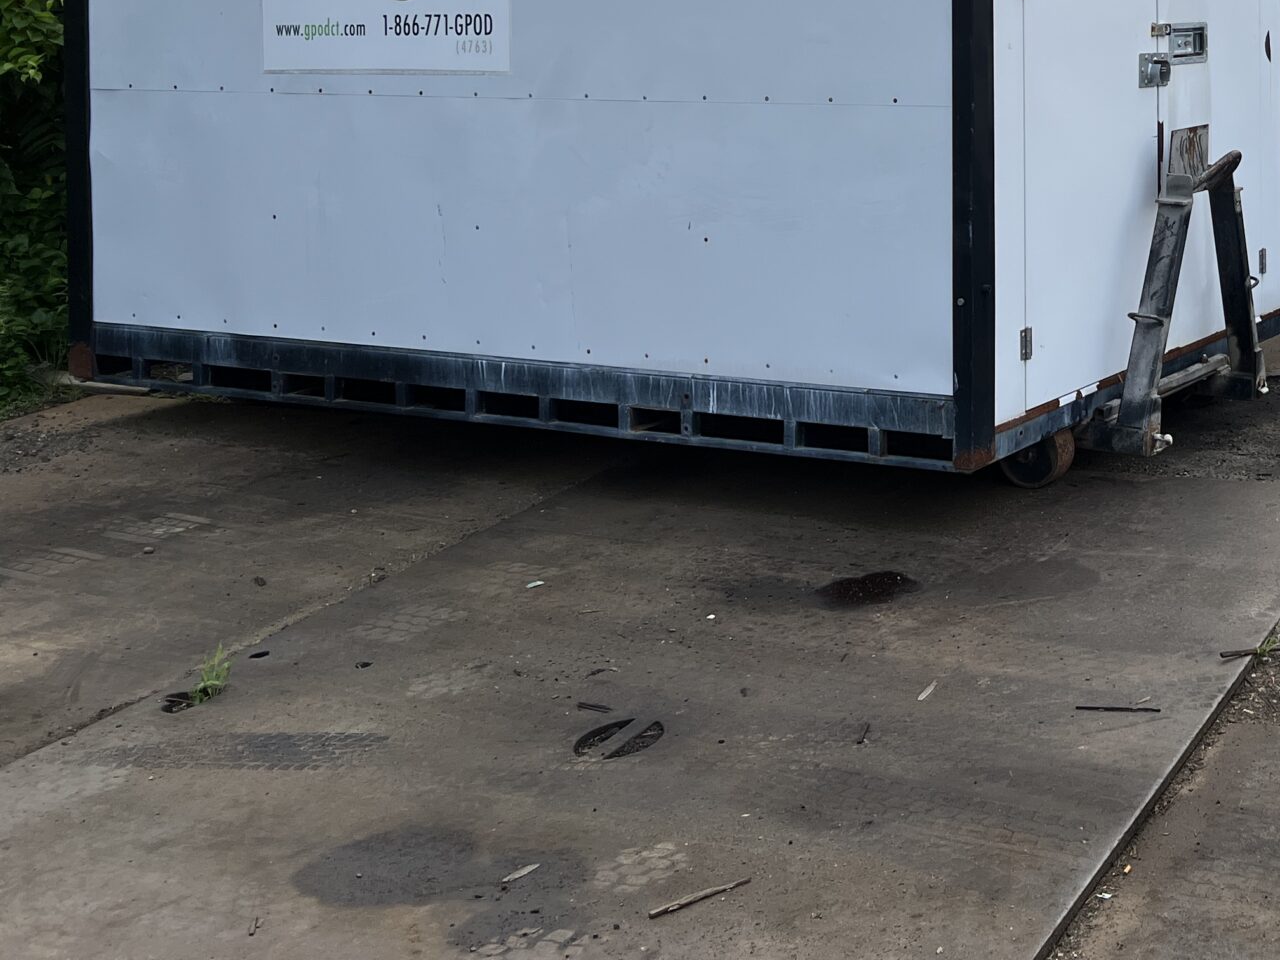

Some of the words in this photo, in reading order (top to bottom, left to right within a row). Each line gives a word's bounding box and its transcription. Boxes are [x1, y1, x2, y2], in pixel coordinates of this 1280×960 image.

[276, 17, 366, 40] www.gpodct.com
[382, 14, 493, 37] 1-866-771-GPOD
[456, 40, 493, 55] (4763)
